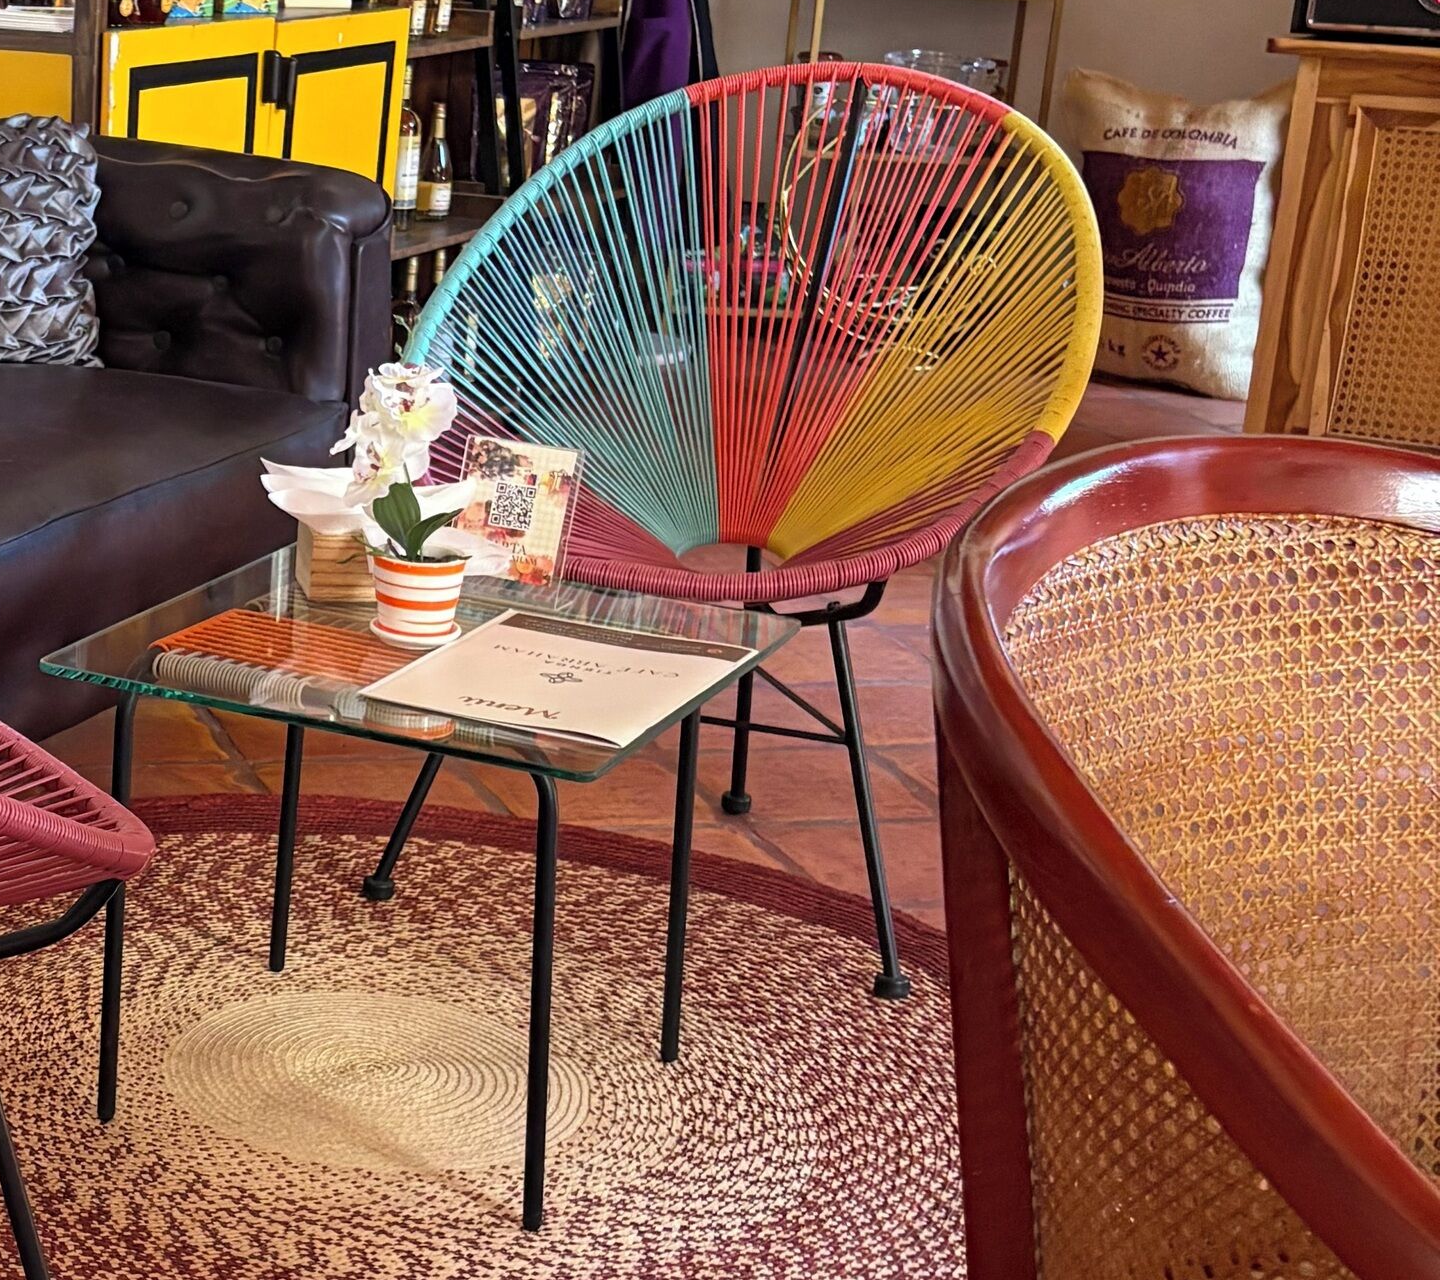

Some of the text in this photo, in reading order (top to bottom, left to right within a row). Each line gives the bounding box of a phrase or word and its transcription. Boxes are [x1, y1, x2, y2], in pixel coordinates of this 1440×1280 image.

[1103, 128, 1238, 150] CAFE DE COLOMBIA
[1116, 241, 1208, 274] Alberto
[1131, 306, 1186, 320] SPECIALTY
[1187, 308, 1231, 319] COFFEE
[457, 694, 561, 721] Menú
